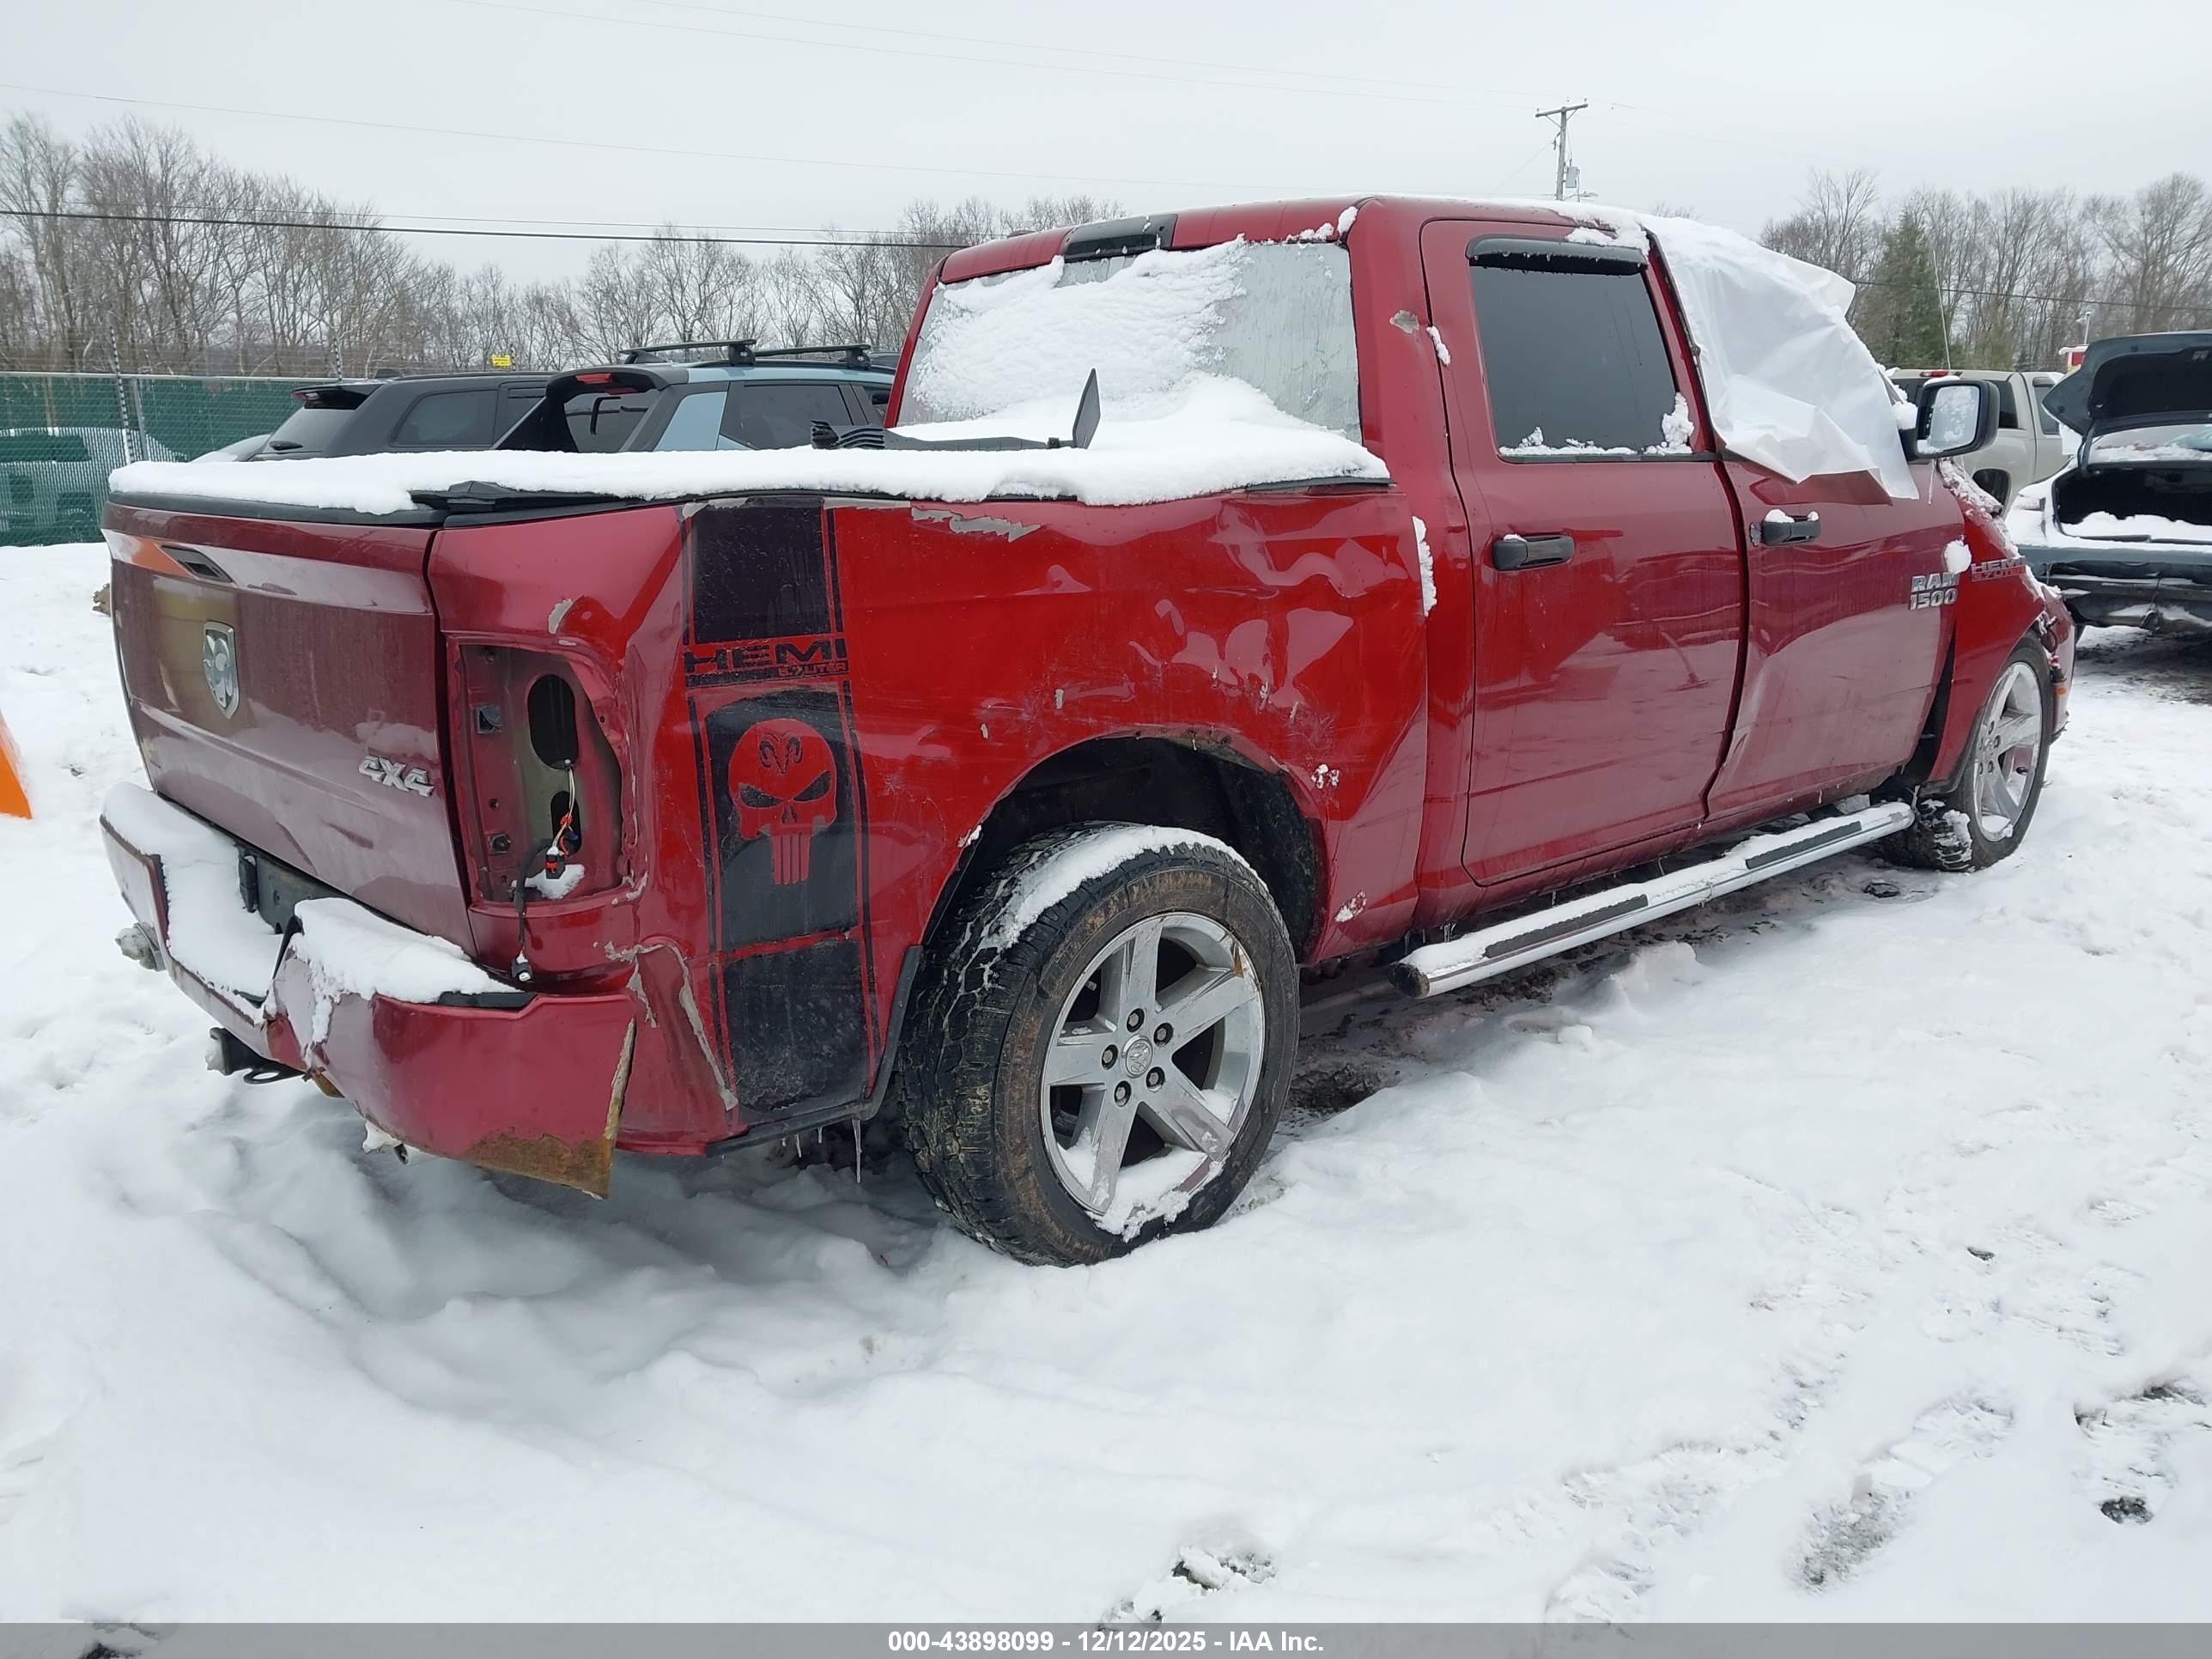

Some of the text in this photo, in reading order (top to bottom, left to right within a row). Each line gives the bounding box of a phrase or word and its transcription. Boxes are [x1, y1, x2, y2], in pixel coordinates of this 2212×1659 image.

[1971, 557, 2027, 574] HEMI
[1911, 571, 1960, 592] RAM
[1910, 587, 1959, 611] 1500
[684, 638, 848, 673] HEMI
